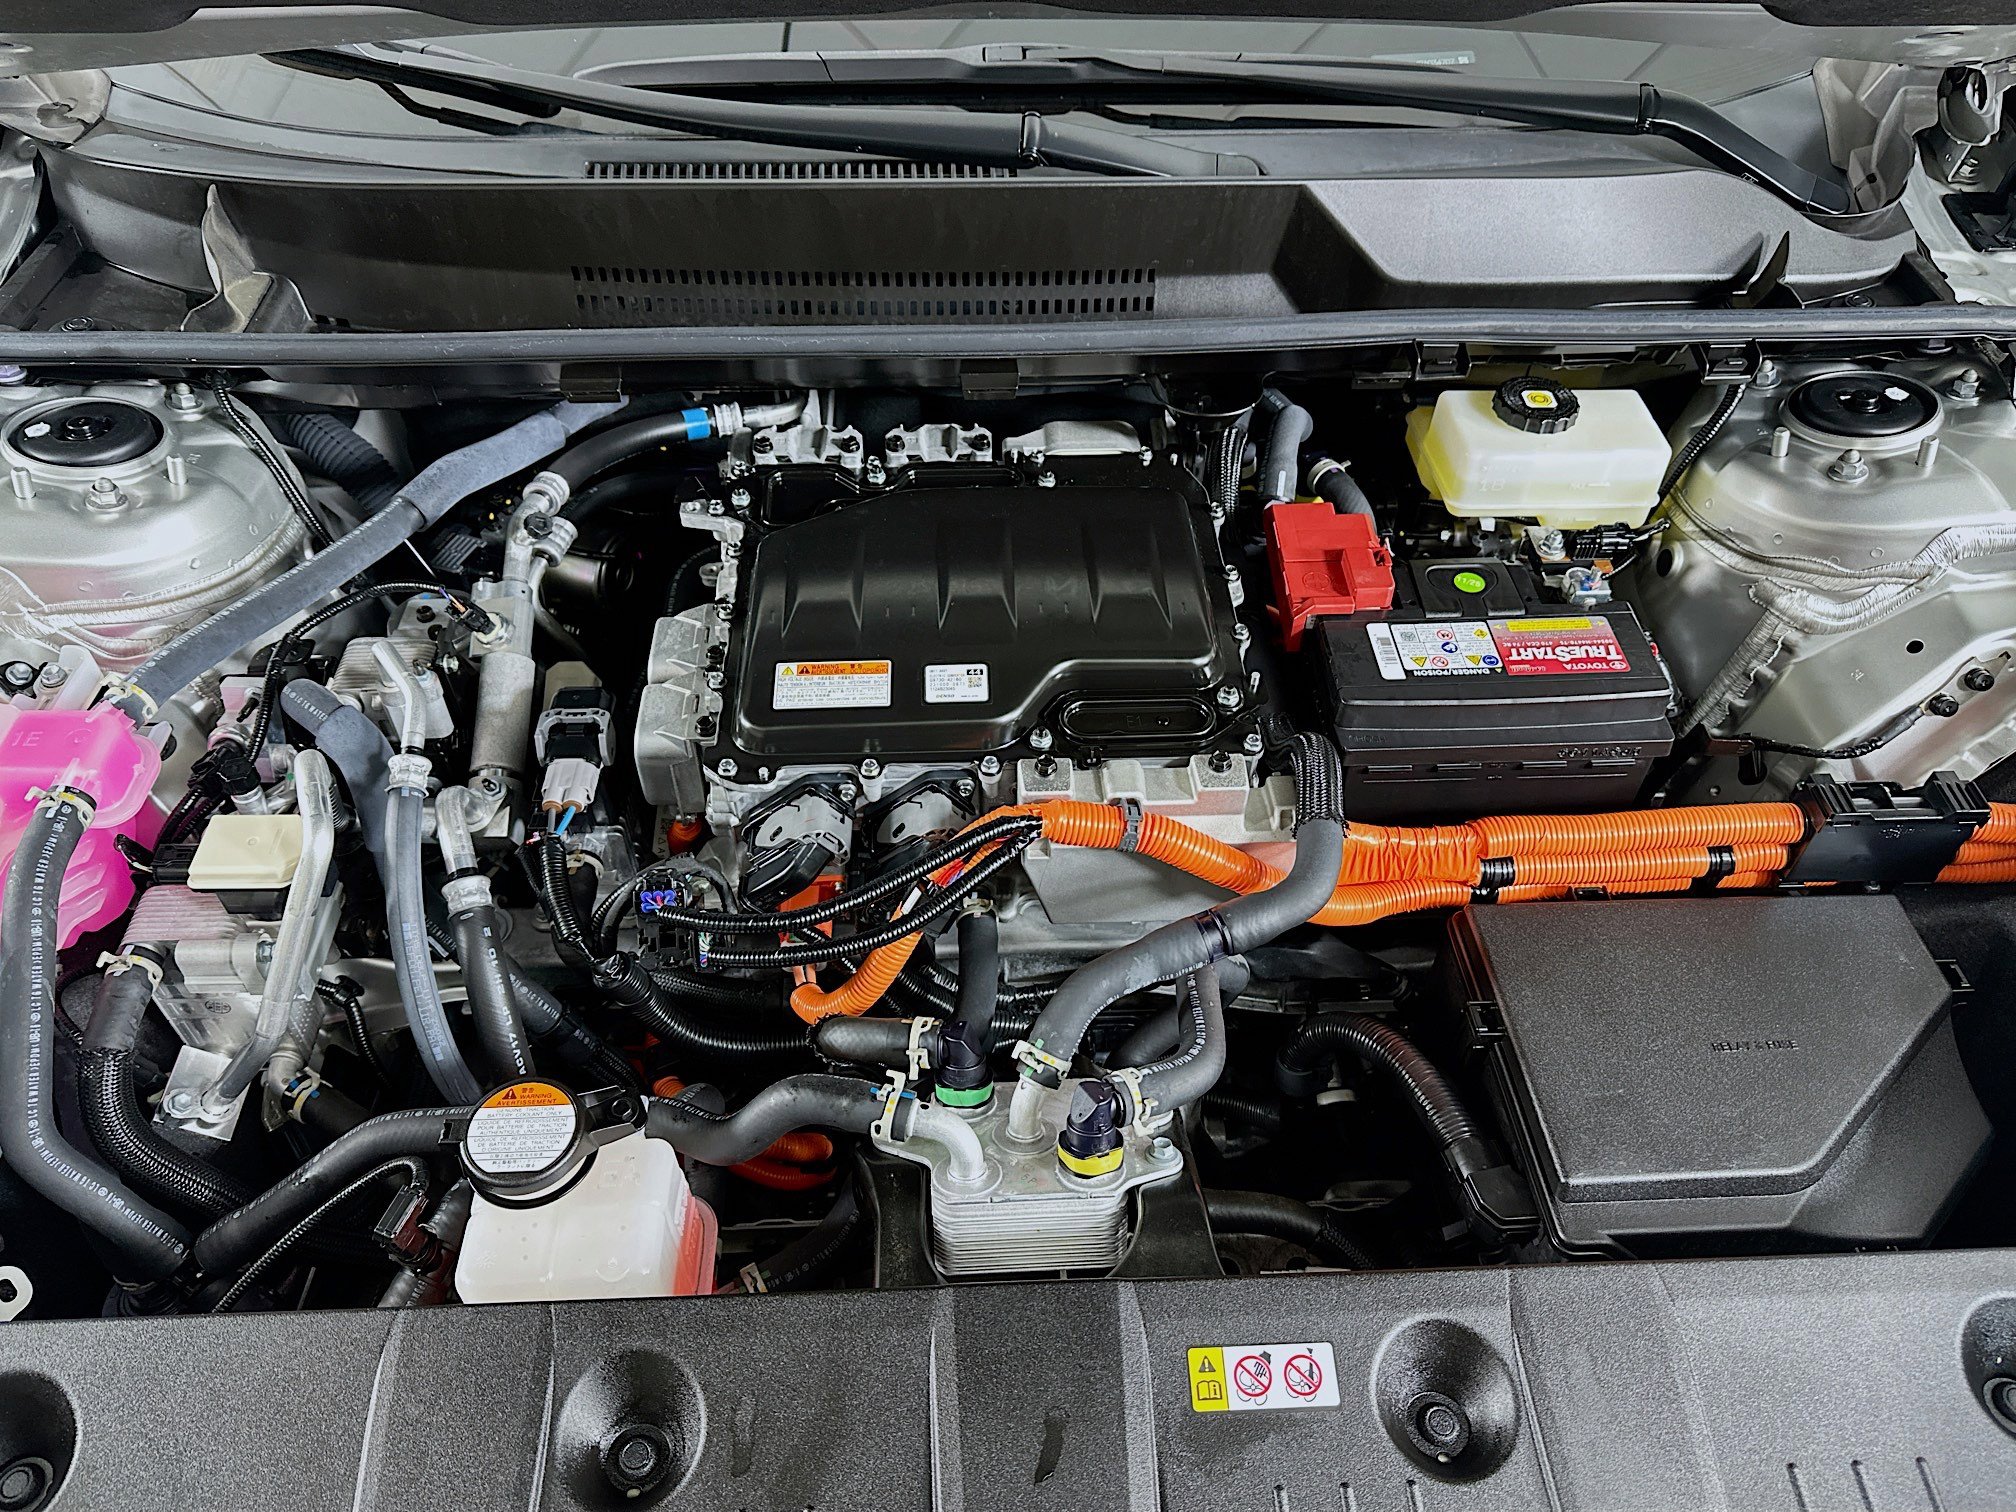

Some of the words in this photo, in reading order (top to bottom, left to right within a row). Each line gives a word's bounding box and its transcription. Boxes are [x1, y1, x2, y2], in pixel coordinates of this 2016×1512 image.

[1413, 668, 1490, 676] DANGER/POISON
[1563, 662, 1608, 670] TOYOTA
[34, 858, 49, 883] WATER
[31, 965, 43, 989] WATER
[501, 1005, 513, 1026] LP
[508, 1031, 527, 1075] ACV17
[28, 1071, 40, 1096] WATER
[497, 1098, 557, 1106] AVERTISSEMENT
[56, 1162, 82, 1182] WATER
[140, 1216, 165, 1239] WATER
